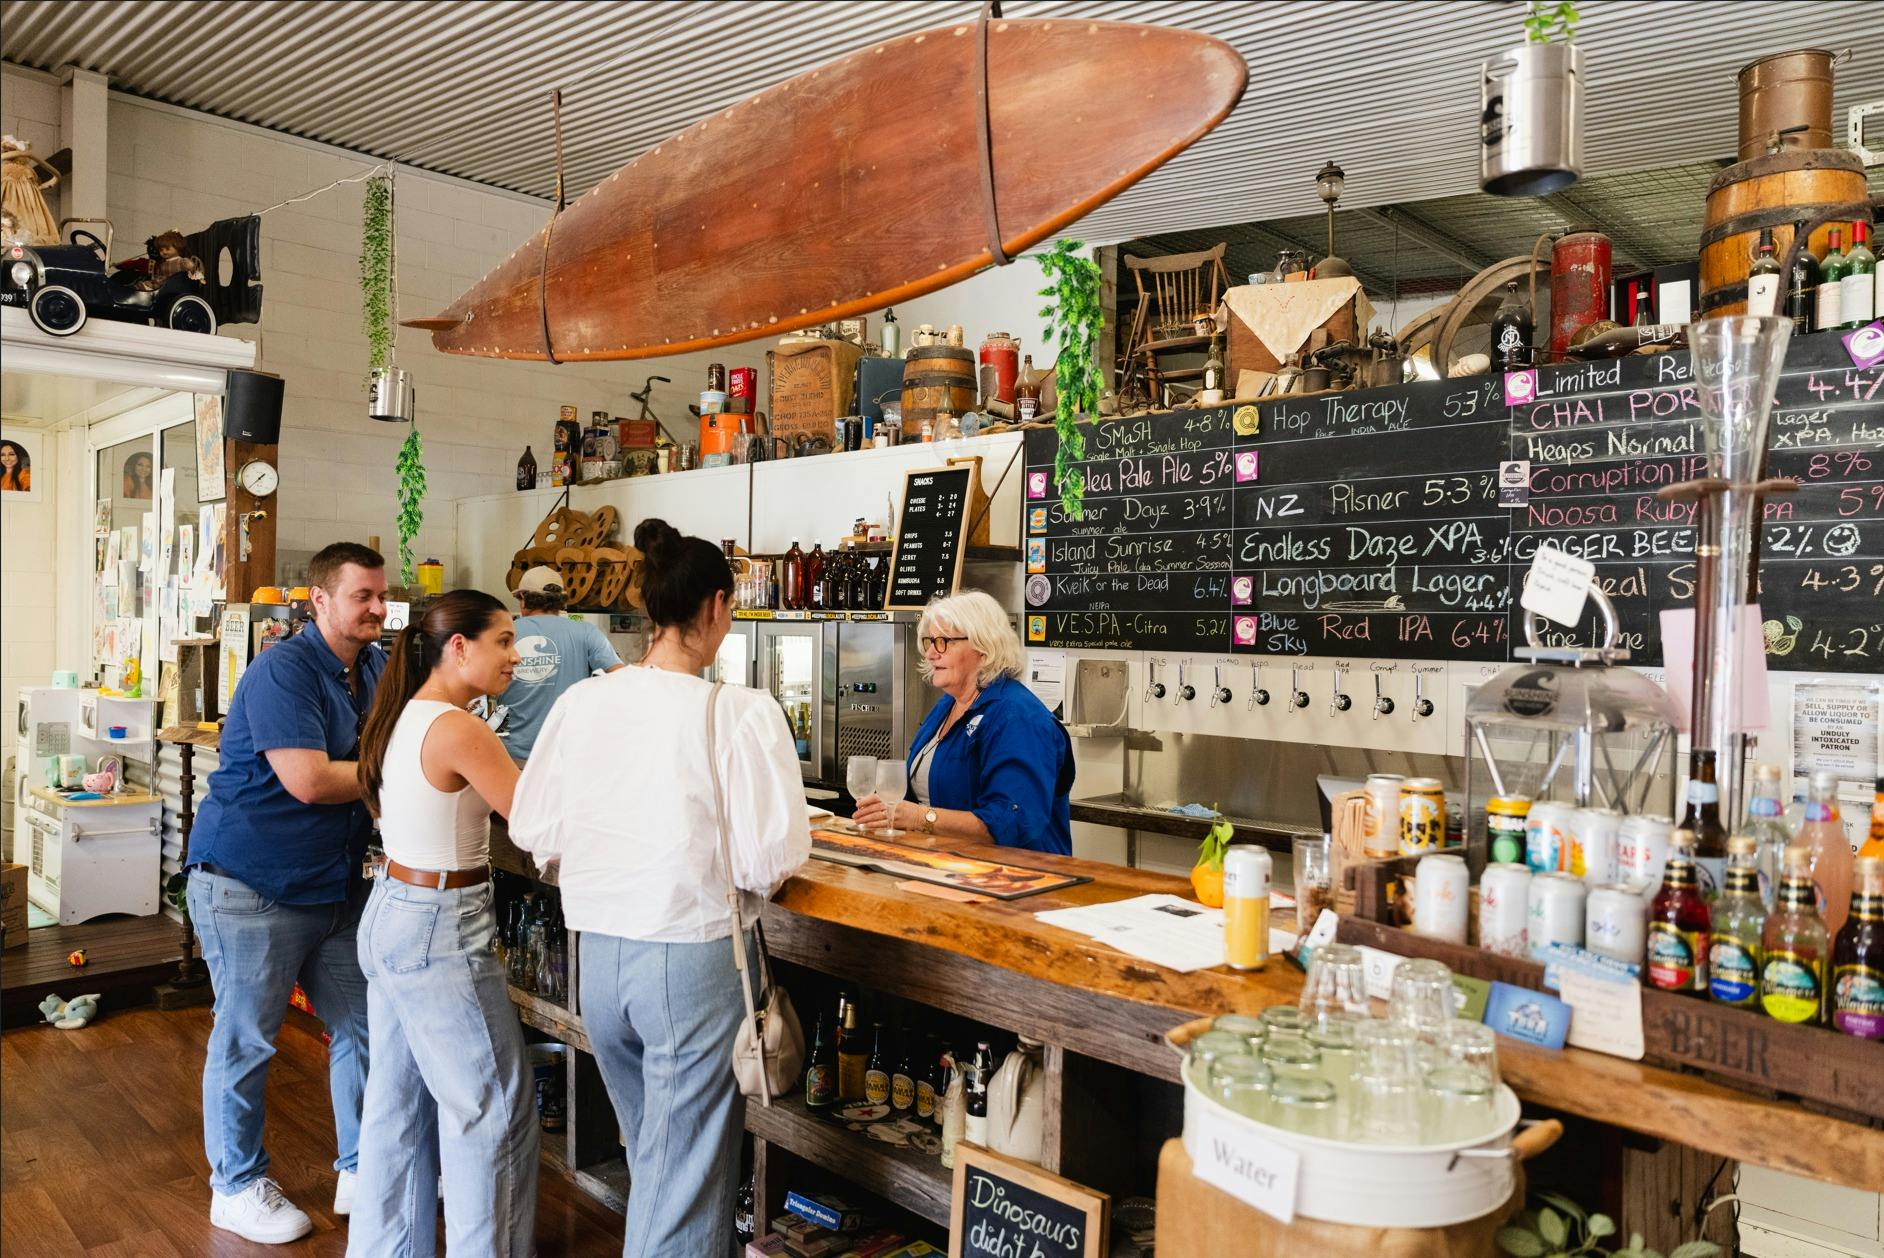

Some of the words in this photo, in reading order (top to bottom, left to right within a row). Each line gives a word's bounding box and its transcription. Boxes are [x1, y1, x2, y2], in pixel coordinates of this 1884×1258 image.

[1535, 359, 1620, 396] Limited
[1273, 405, 1310, 433] Hop
[1320, 396, 1409, 426] Therapy
[1531, 399, 1604, 429] CHAI
[1776, 410, 1835, 425] Lager
[1096, 420, 1151, 449] SMaSH
[1351, 426, 1376, 436] INDIA
[1087, 451, 1110, 461] Single
[1115, 446, 1135, 459] Malt
[1148, 438, 1176, 455] Single
[1180, 438, 1201, 452] Hop
[1527, 437, 1595, 466] Heaps
[1608, 424, 1696, 455] Normal
[913, 477, 934, 486] SNACKS
[1119, 458, 1152, 493] Pale
[1162, 454, 1193, 485] Ale
[1200, 451, 1233, 484] 5%
[1529, 461, 1674, 493] Corruption
[1808, 450, 1872, 477] 8%
[1123, 497, 1171, 529] Dayz
[1183, 494, 1227, 520] 3.9%
[1256, 494, 1304, 521] NZ
[1328, 483, 1409, 515] Pilsner
[1528, 503, 1617, 527] Noosa
[1635, 496, 1698, 526] Ruby
[1072, 525, 1105, 536] summer
[1113, 522, 1127, 534] ale
[1052, 538, 1096, 562] Island
[1105, 536, 1173, 559] Sunrise
[1241, 531, 1331, 562] Endless
[1346, 527, 1417, 567] Daze
[1422, 521, 1484, 556] XPA
[1632, 530, 1699, 557] BEE
[1071, 562, 1099, 580] Juicy
[1107, 561, 1128, 573] Pale
[1155, 559, 1193, 571] Summer
[1056, 575, 1091, 596] Kveik
[1112, 577, 1129, 591] the
[1137, 573, 1169, 592] Dead
[1193, 577, 1228, 599] 6.4%
[1262, 566, 1396, 610] Longboard
[1412, 566, 1495, 605] Lager
[1195, 618, 1228, 636] 5.2%
[1260, 612, 1299, 631] Blue
[1317, 614, 1370, 641] Red
[1398, 615, 1433, 641] IPA
[1267, 634, 1307, 656] Sky
[516, 666, 549, 674] BREWERY
[519, 655, 562, 667] NSHINE
[1336, 660, 1350, 668] Red
[1411, 662, 1444, 674] Summer
[1811, 736, 1860, 745] INTOXICATED
[1820, 743, 1850, 751] PATRON
[1663, 1008, 1770, 1078] BEER
[1213, 1137, 1279, 1190] Water
[970, 1175, 1080, 1250] Dinosaurs
[970, 1218, 1026, 1258] didn't
